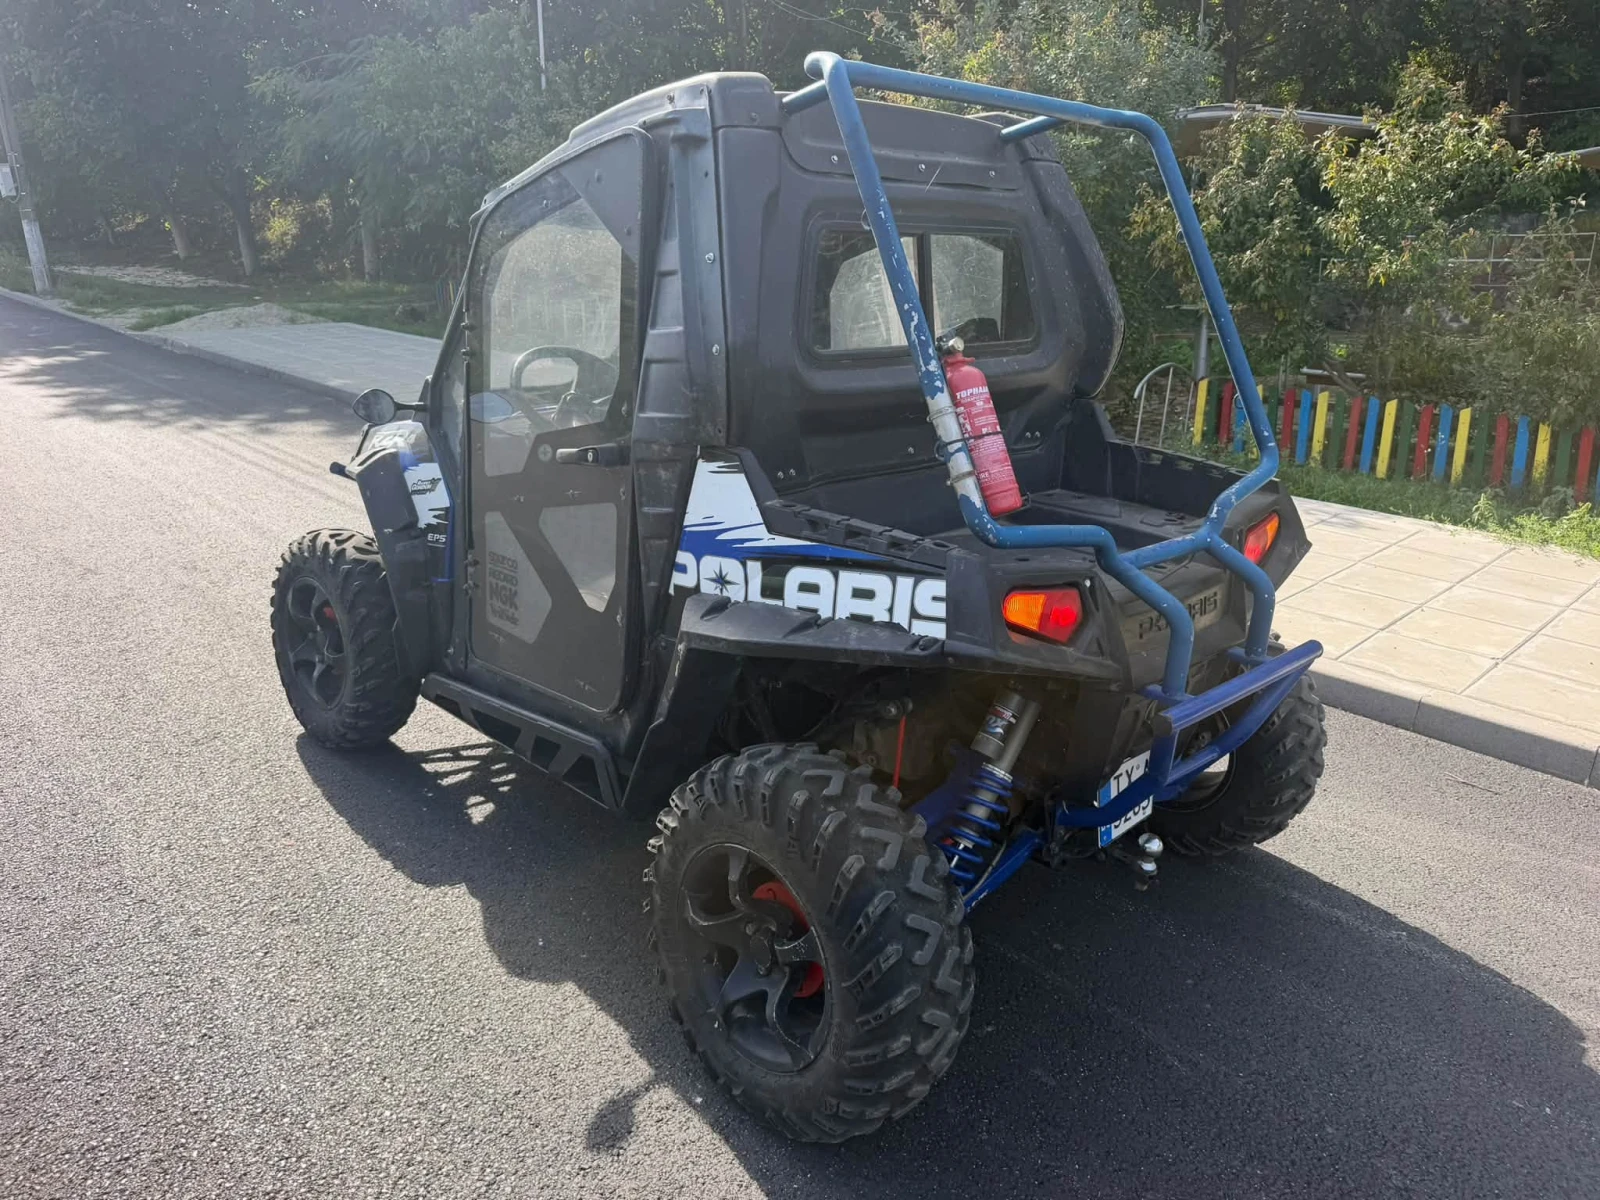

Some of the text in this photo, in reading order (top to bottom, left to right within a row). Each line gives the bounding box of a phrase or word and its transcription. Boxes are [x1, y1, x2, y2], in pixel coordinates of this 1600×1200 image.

[427, 533, 447, 543] EPS
[489, 582, 519, 611] NGK
[669, 550, 947, 640] POLARIS
